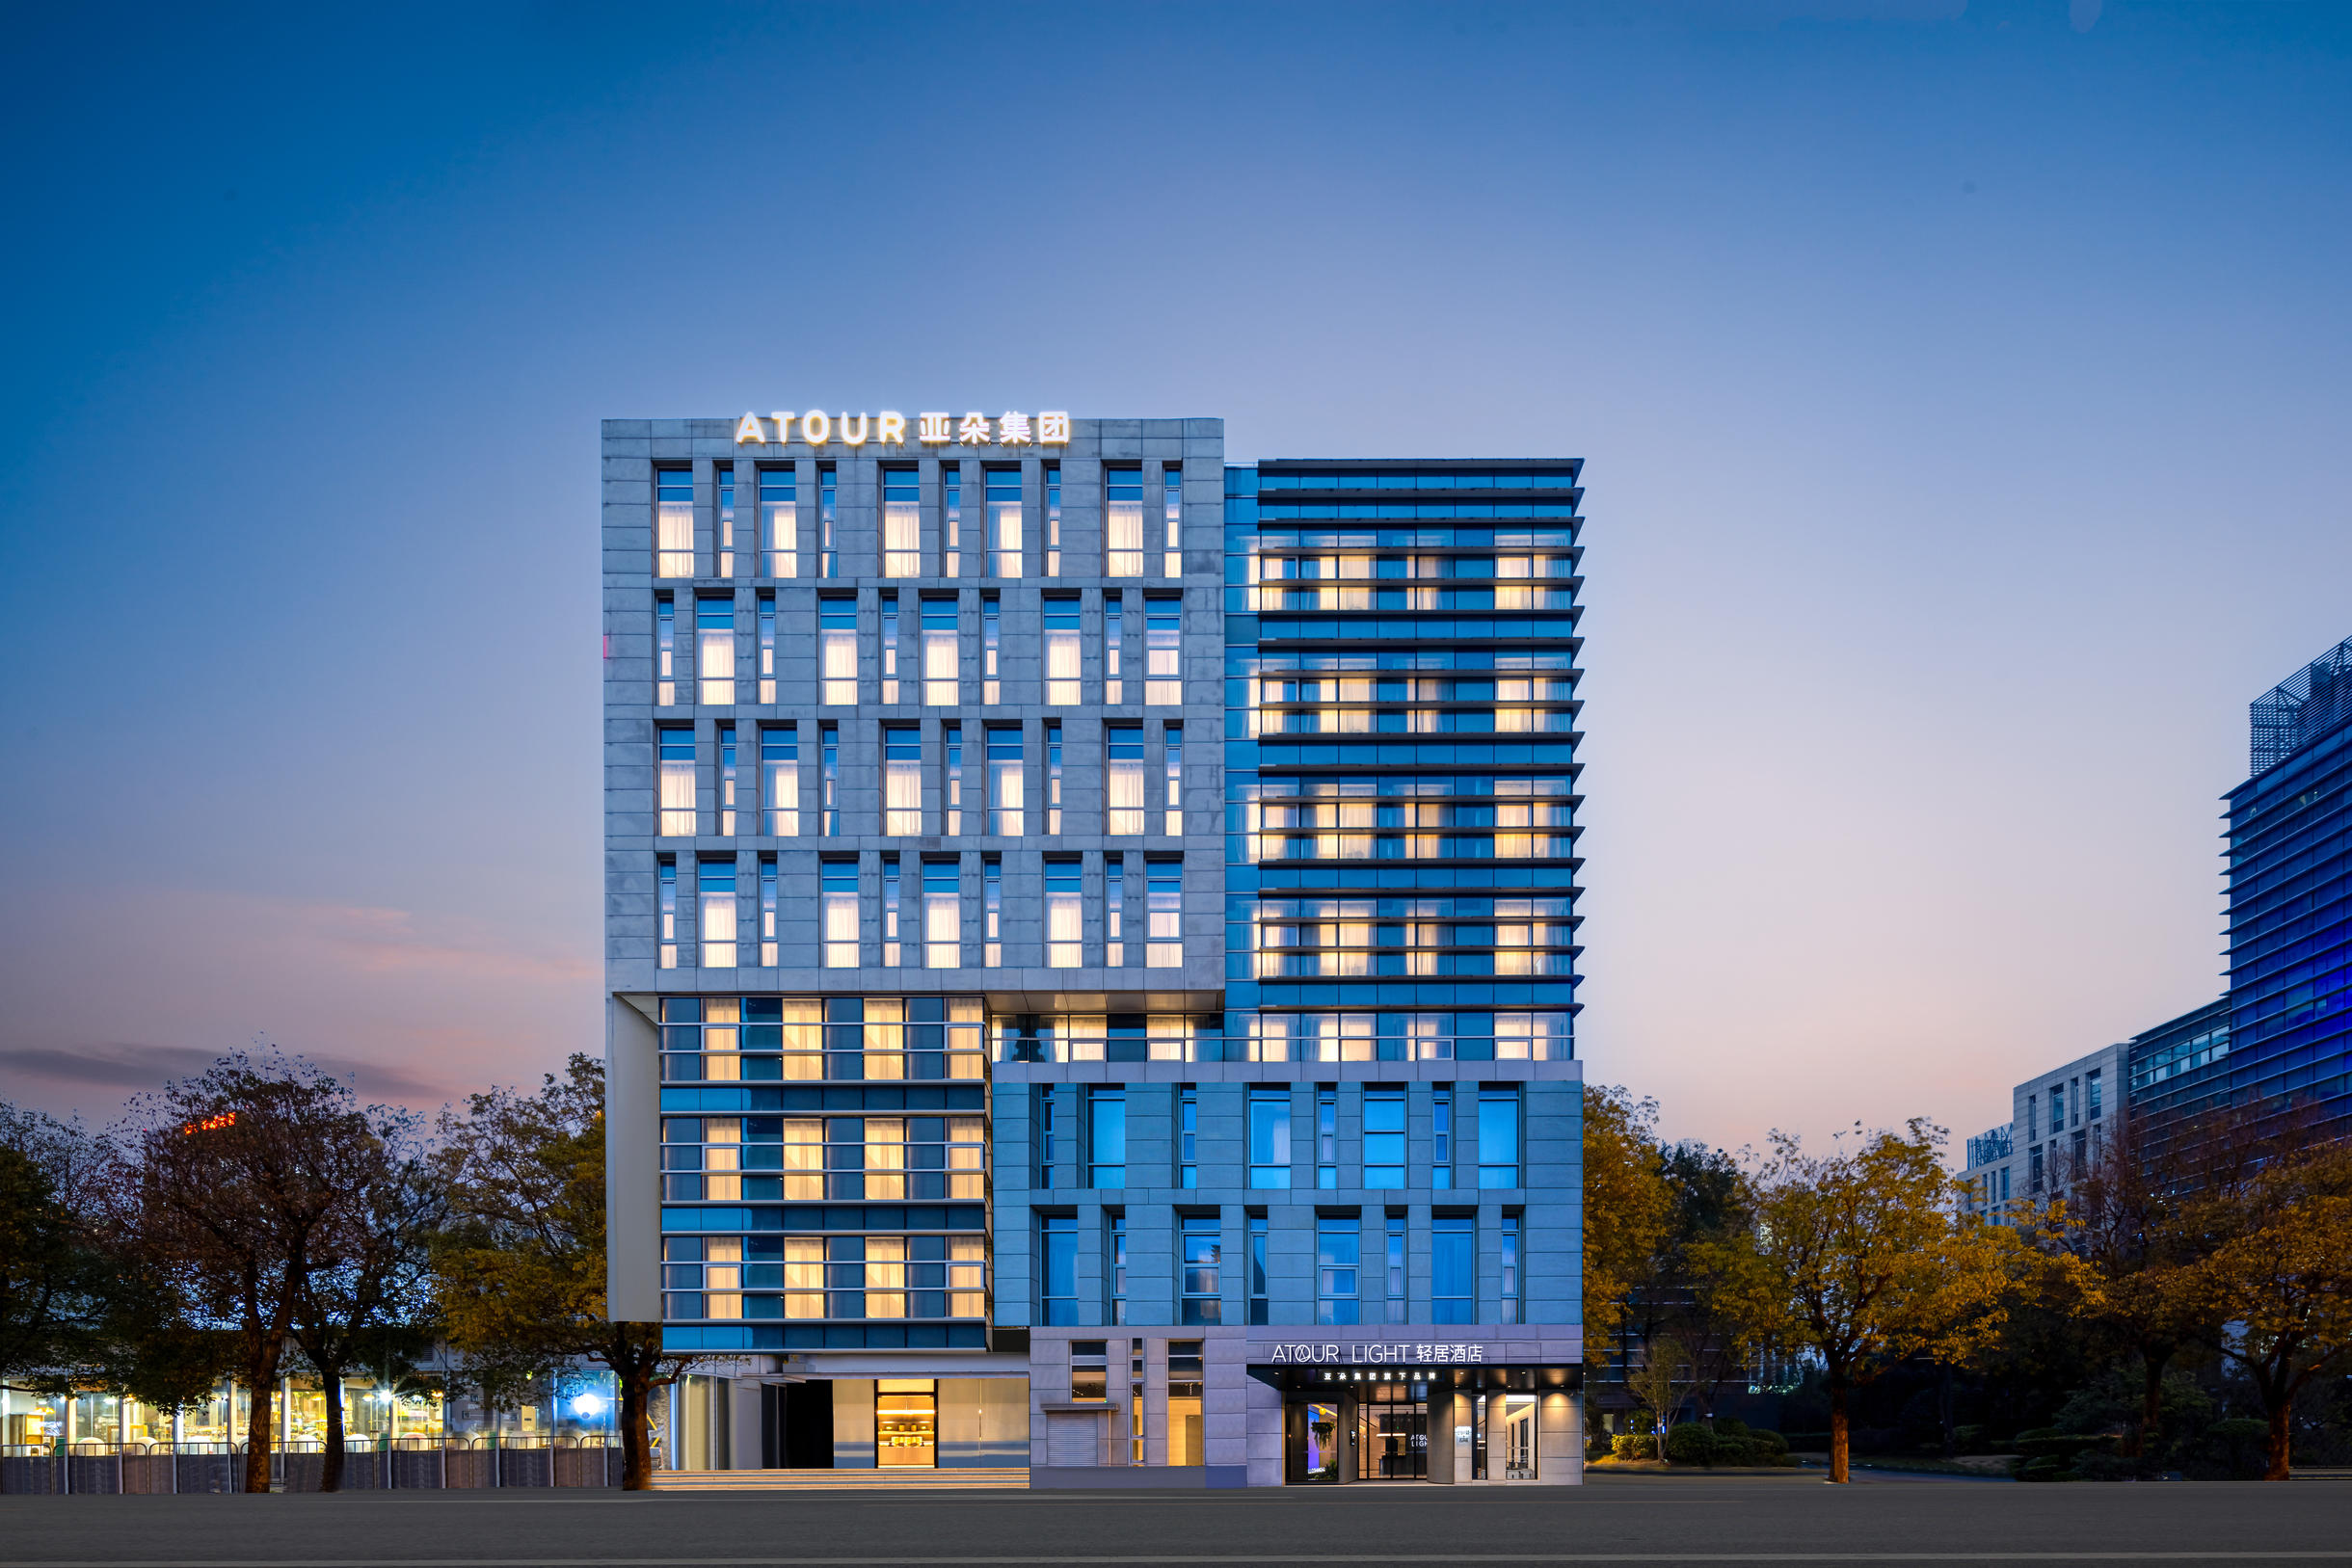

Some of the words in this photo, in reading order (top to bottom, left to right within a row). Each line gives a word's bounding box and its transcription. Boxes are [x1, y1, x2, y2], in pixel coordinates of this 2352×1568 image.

[735, 410, 906, 444] ATOUR
[920, 411, 1071, 444] 亚朵集团
[1271, 1344, 1339, 1363] ATOUR
[1351, 1344, 1410, 1363] LIGHT
[1416, 1343, 1483, 1363] 轻居酒店
[1323, 1371, 1436, 1381] 亚朵集团旗下品牌
